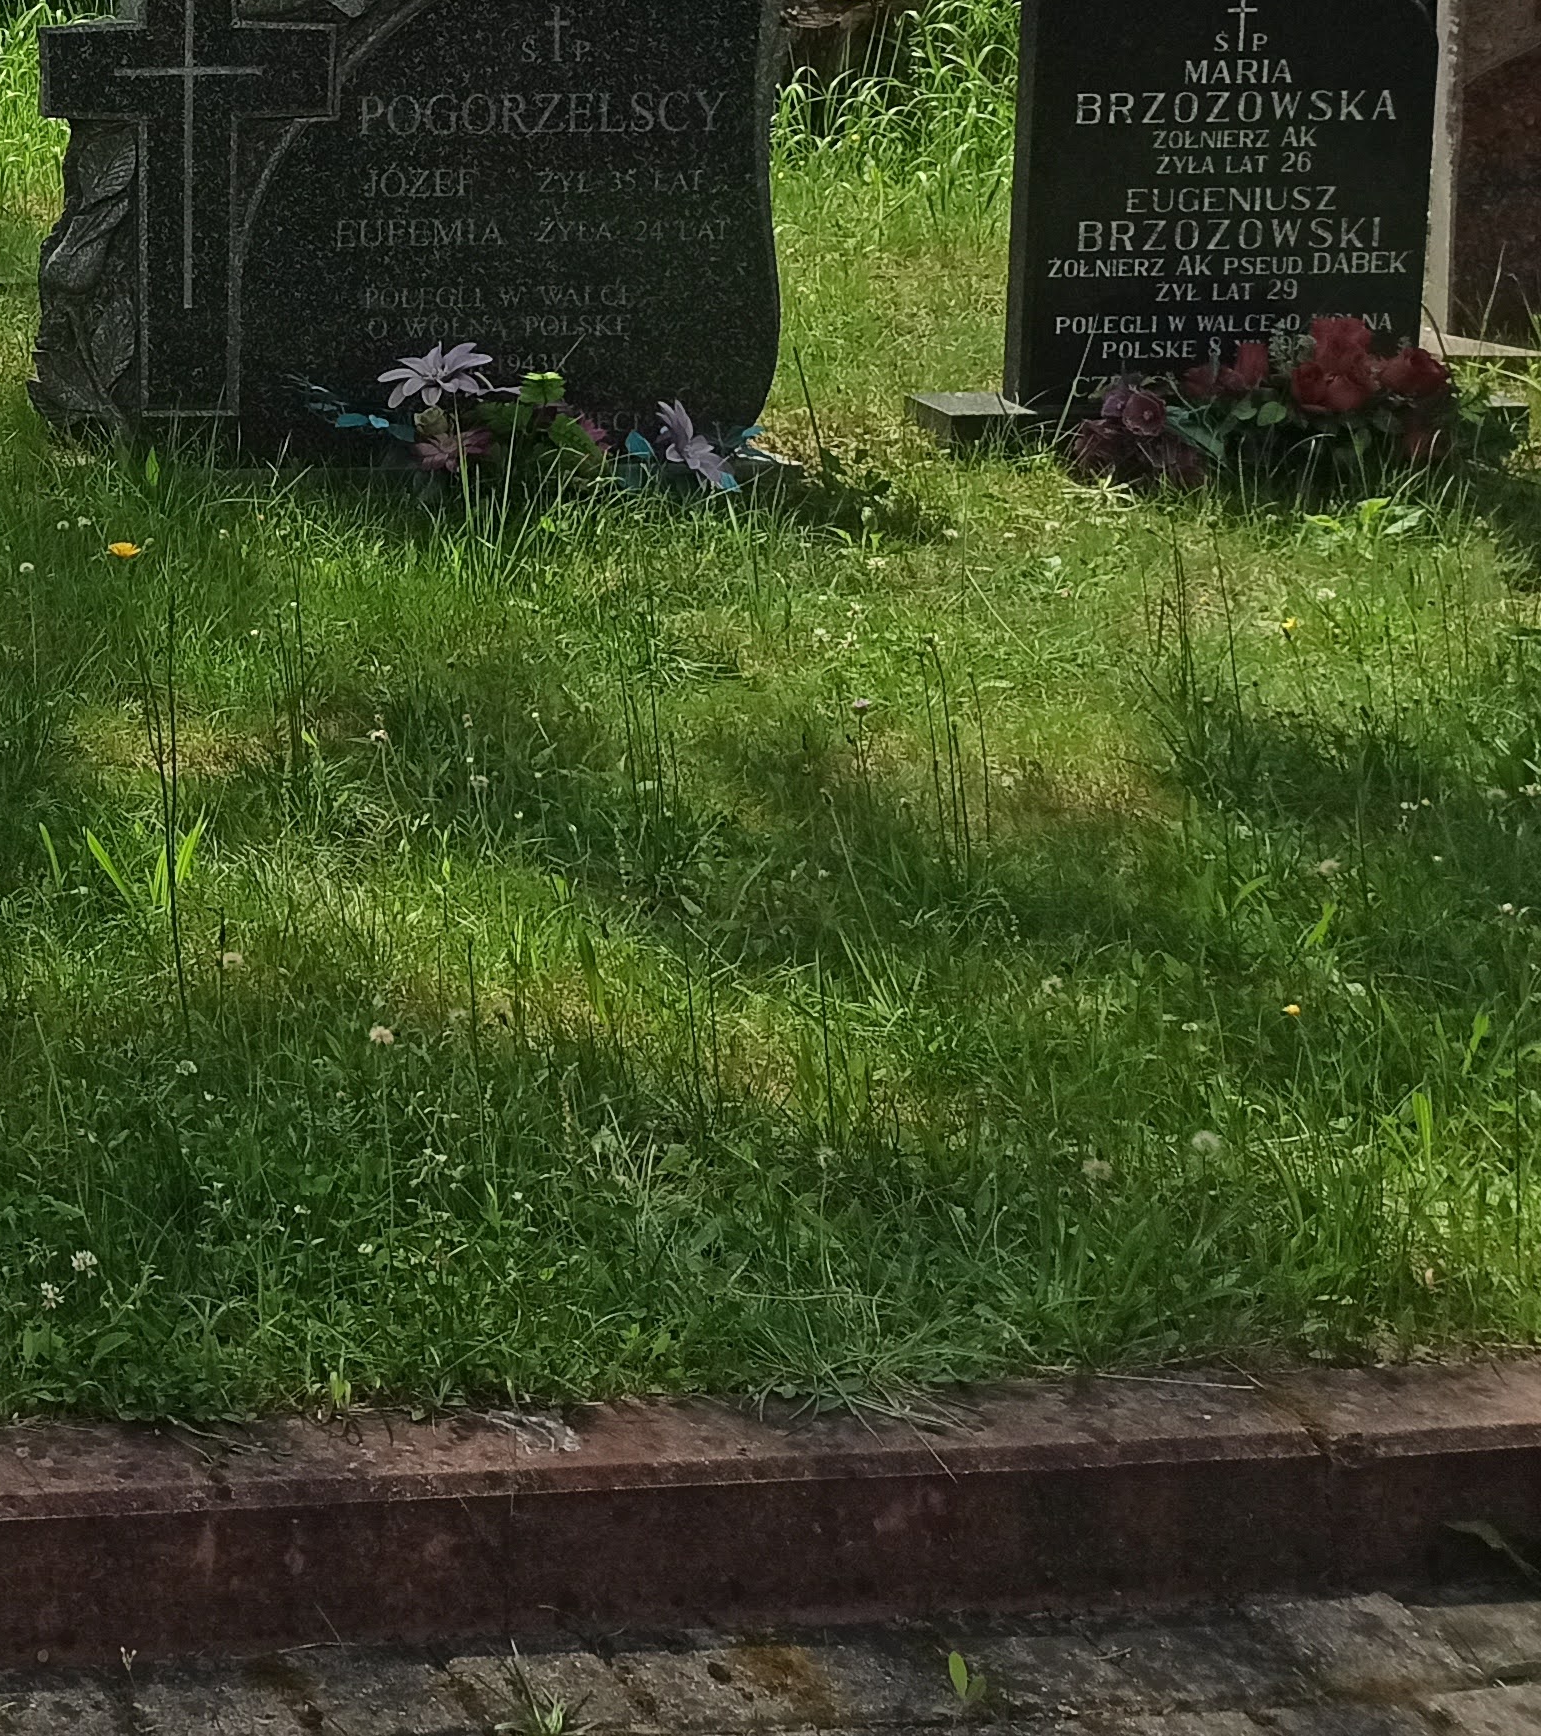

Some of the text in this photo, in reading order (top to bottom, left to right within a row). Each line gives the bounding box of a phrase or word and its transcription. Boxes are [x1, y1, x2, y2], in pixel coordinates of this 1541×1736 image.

[1185, 59, 1293, 85] MARIA
[360, 90, 729, 136] POGORZELSCY
[1076, 88, 1397, 125] BRZOZOWSKA
[1153, 127, 1317, 150] ŻOŁNIERZ AK
[1156, 152, 1312, 176] ŻYŁA LAT 26
[365, 163, 705, 197] JÓZEF 35 LAT
[1125, 185, 1338, 213] EUGENIUSZ
[336, 219, 505, 249] EUFEMIA
[635, 221, 663, 241] 24
[679, 220, 731, 241] LAT
[1077, 217, 1381, 252] BRZOZOWSKI
[1047, 257, 1165, 279] ŻOŁNIERZ
[1176, 255, 1212, 276] AK
[365, 286, 483, 309] POLEGLI
[500, 286, 521, 306] W
[1155, 279, 1298, 303] ŻYŁ LAT 29
[366, 318, 387, 339] O
[1055, 316, 1158, 335] POLEGLI
[1166, 315, 1187, 333] W
[1197, 315, 1273, 334] WALCE
[1287, 314, 1302, 331] O
